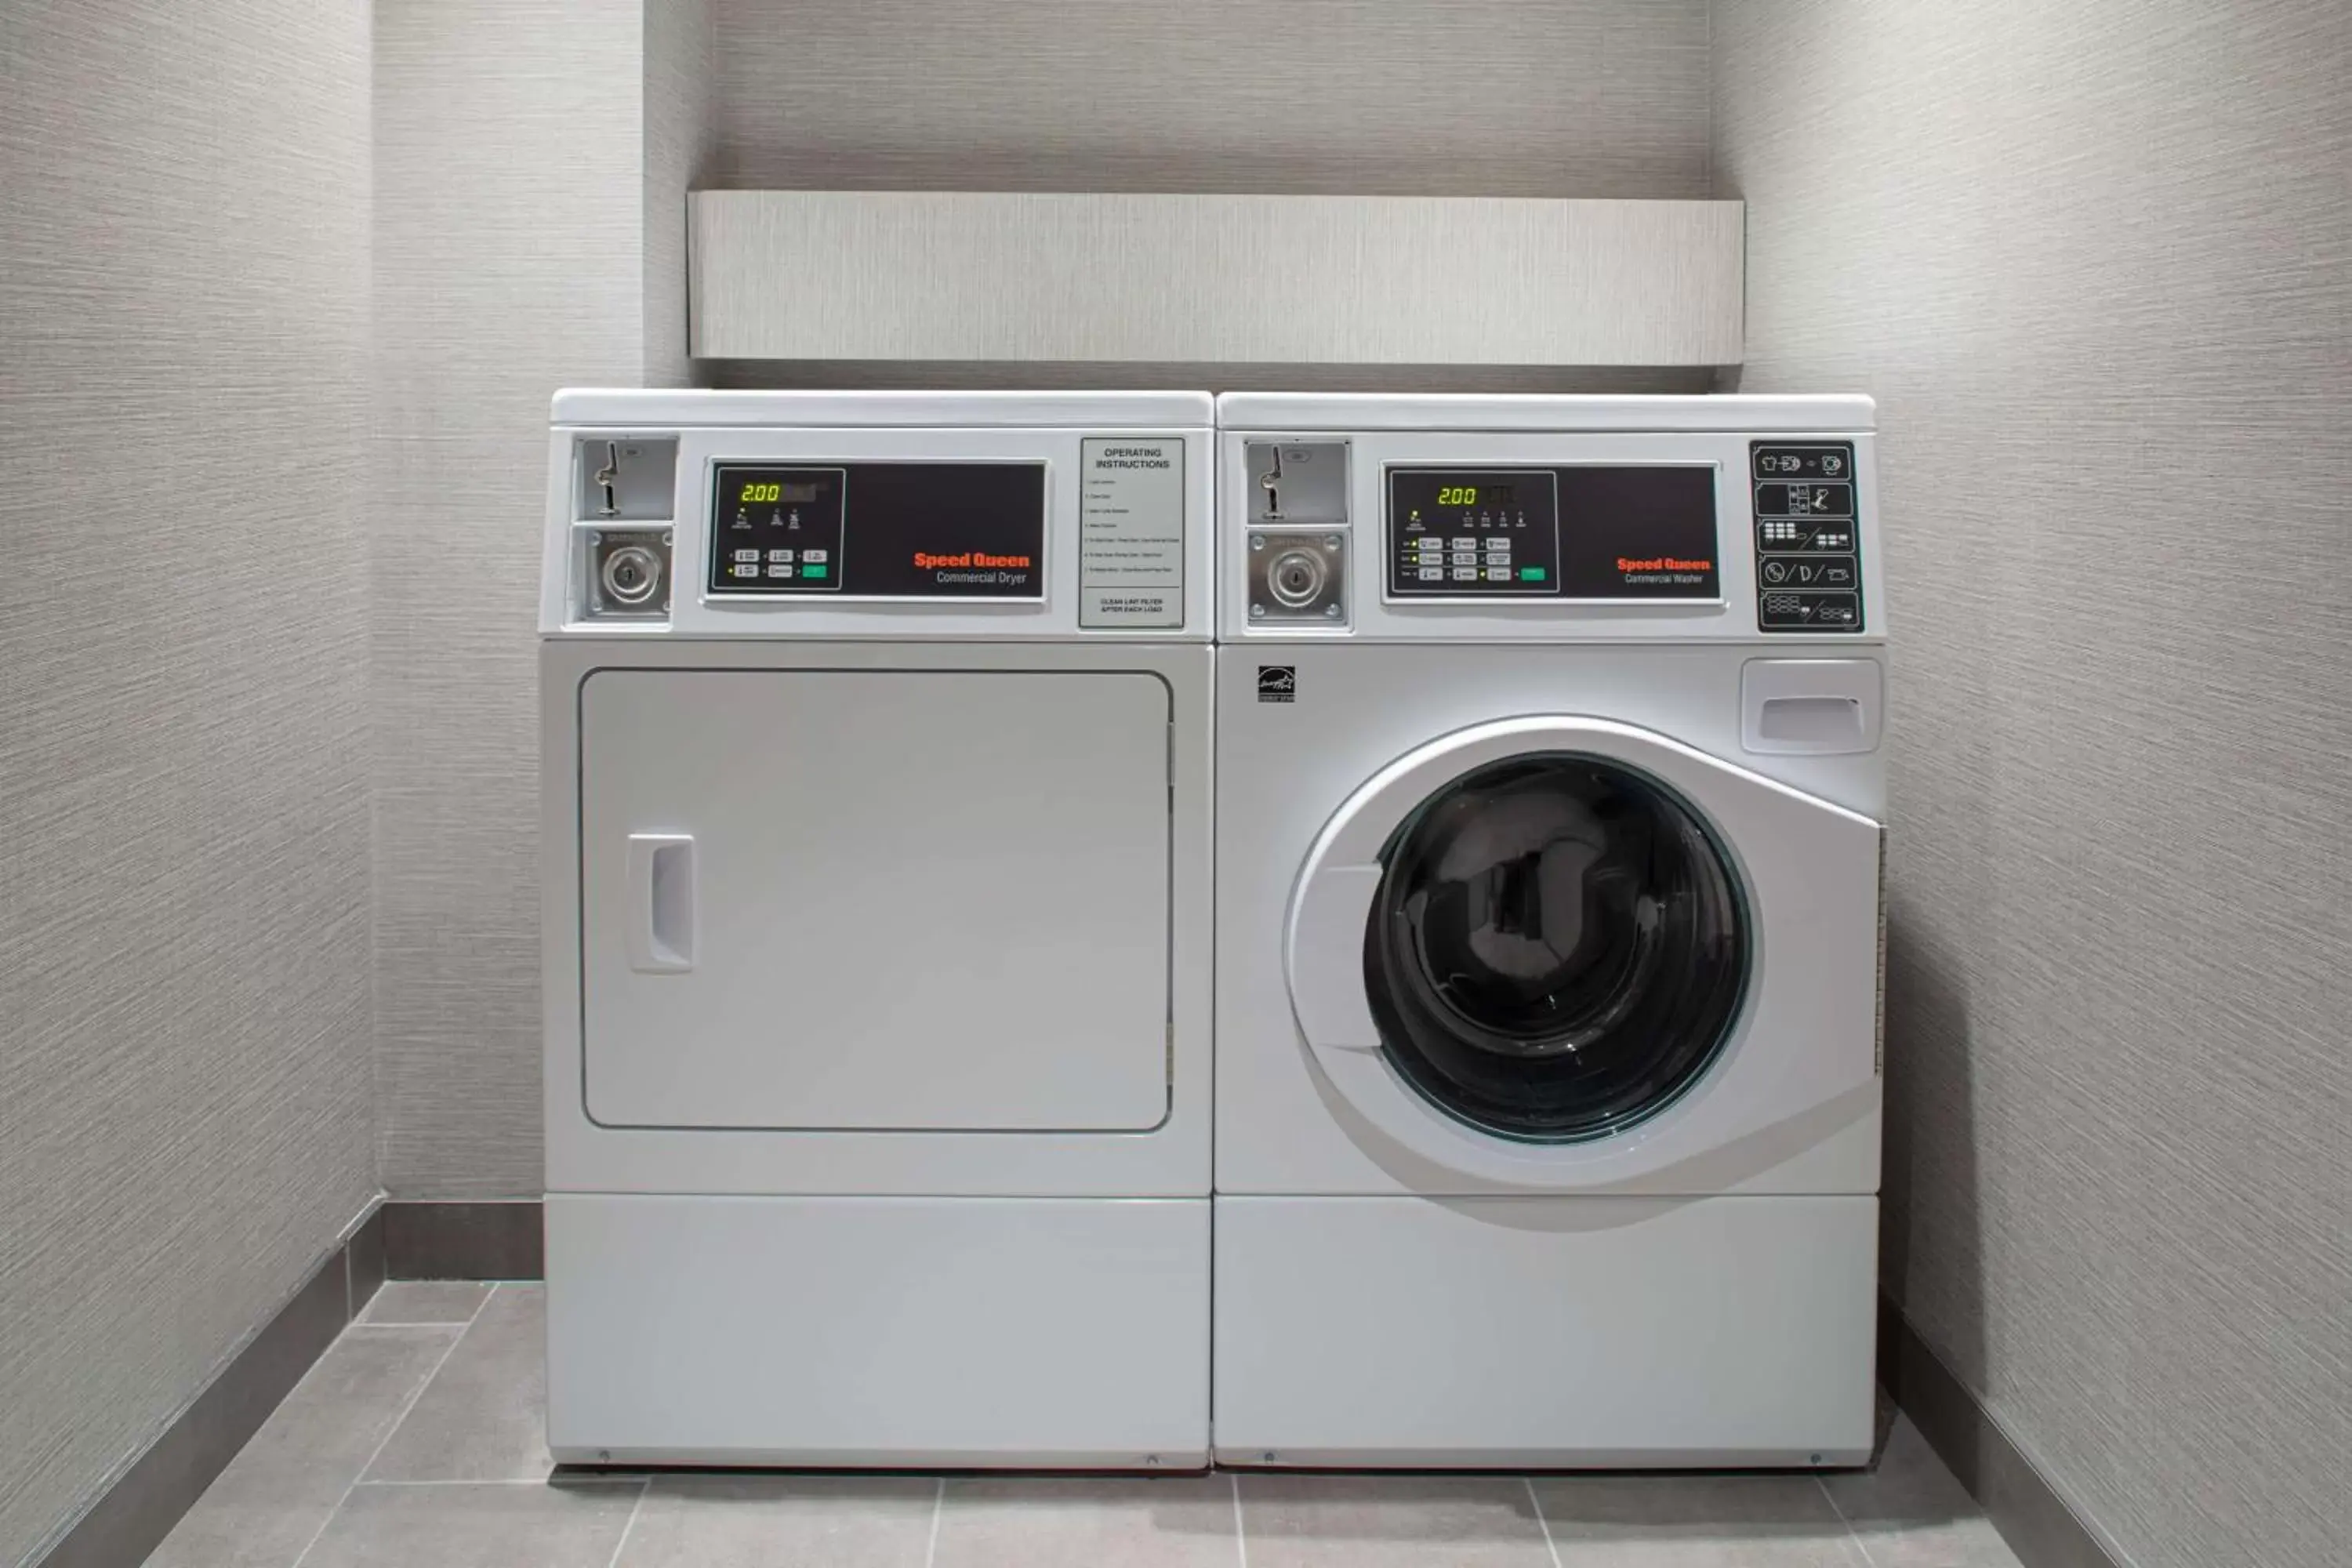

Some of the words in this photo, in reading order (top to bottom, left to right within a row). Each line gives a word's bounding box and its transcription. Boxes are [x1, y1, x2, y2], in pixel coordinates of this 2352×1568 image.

[1104, 448, 1161, 457] OPERATING
[1096, 460, 1170, 469] INSTRUCTIONS
[741, 484, 779, 501] 2.00
[1438, 488, 1476, 505] 2.00
[914, 552, 971, 569] Speed
[973, 552, 1030, 568] Queen
[1617, 557, 1662, 572] Speed
[1664, 557, 1711, 570] Queen
[937, 571, 996, 583] Commercial
[998, 572, 1027, 585] Dryer
[1625, 573, 1671, 583] Commercial
[1672, 574, 1703, 583] Washer
